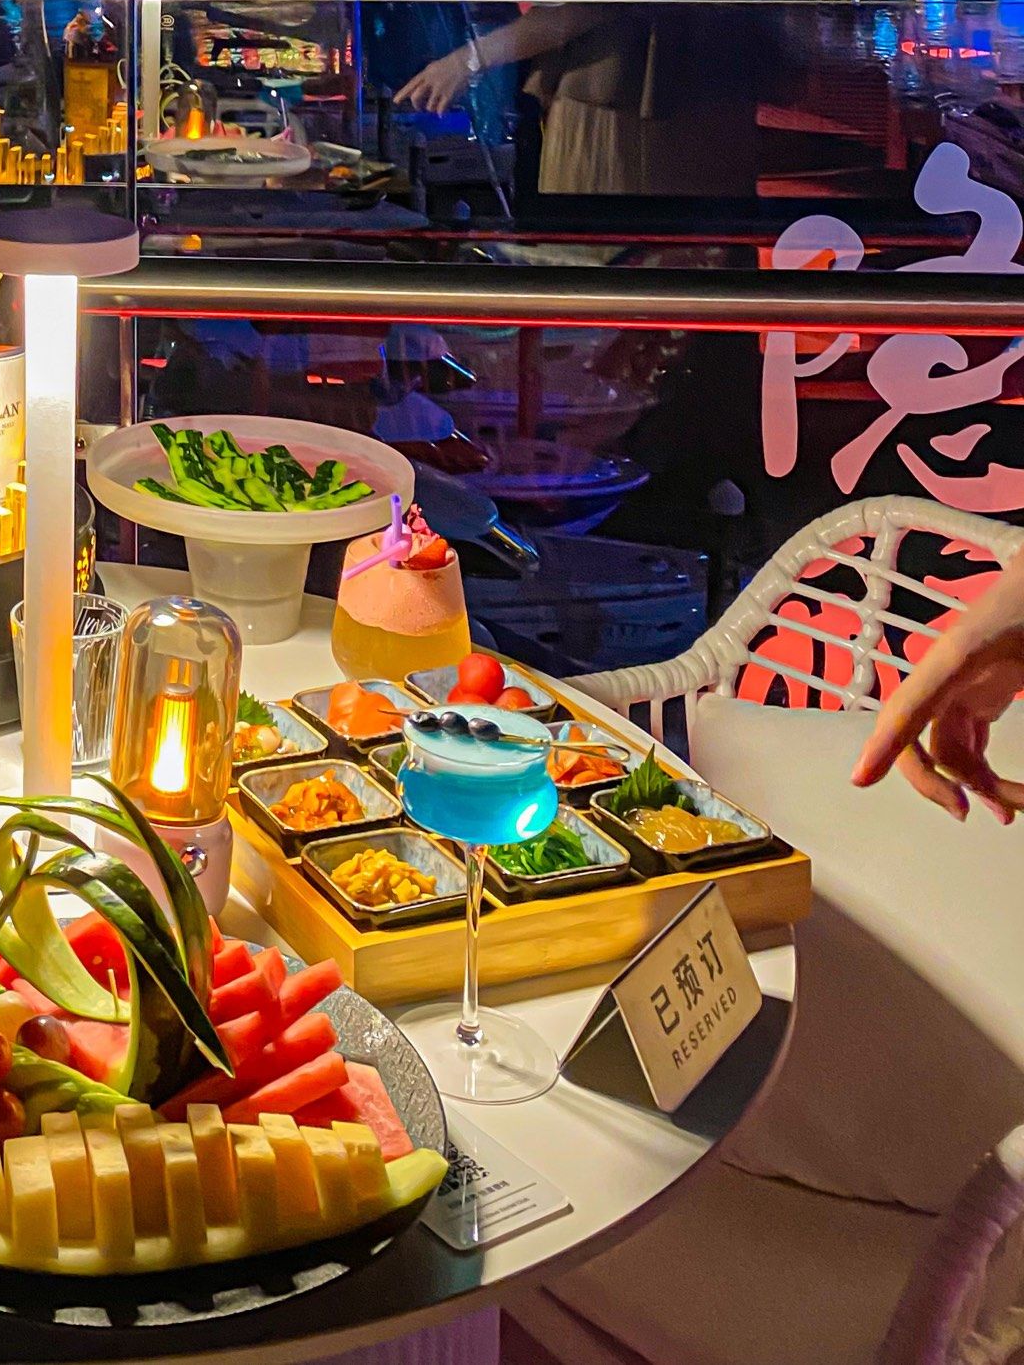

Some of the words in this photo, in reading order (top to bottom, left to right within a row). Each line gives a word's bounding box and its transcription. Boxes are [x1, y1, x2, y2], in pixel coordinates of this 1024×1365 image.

[650, 930, 724, 1035] 已预订
[672, 987, 737, 1069] RESERVED
